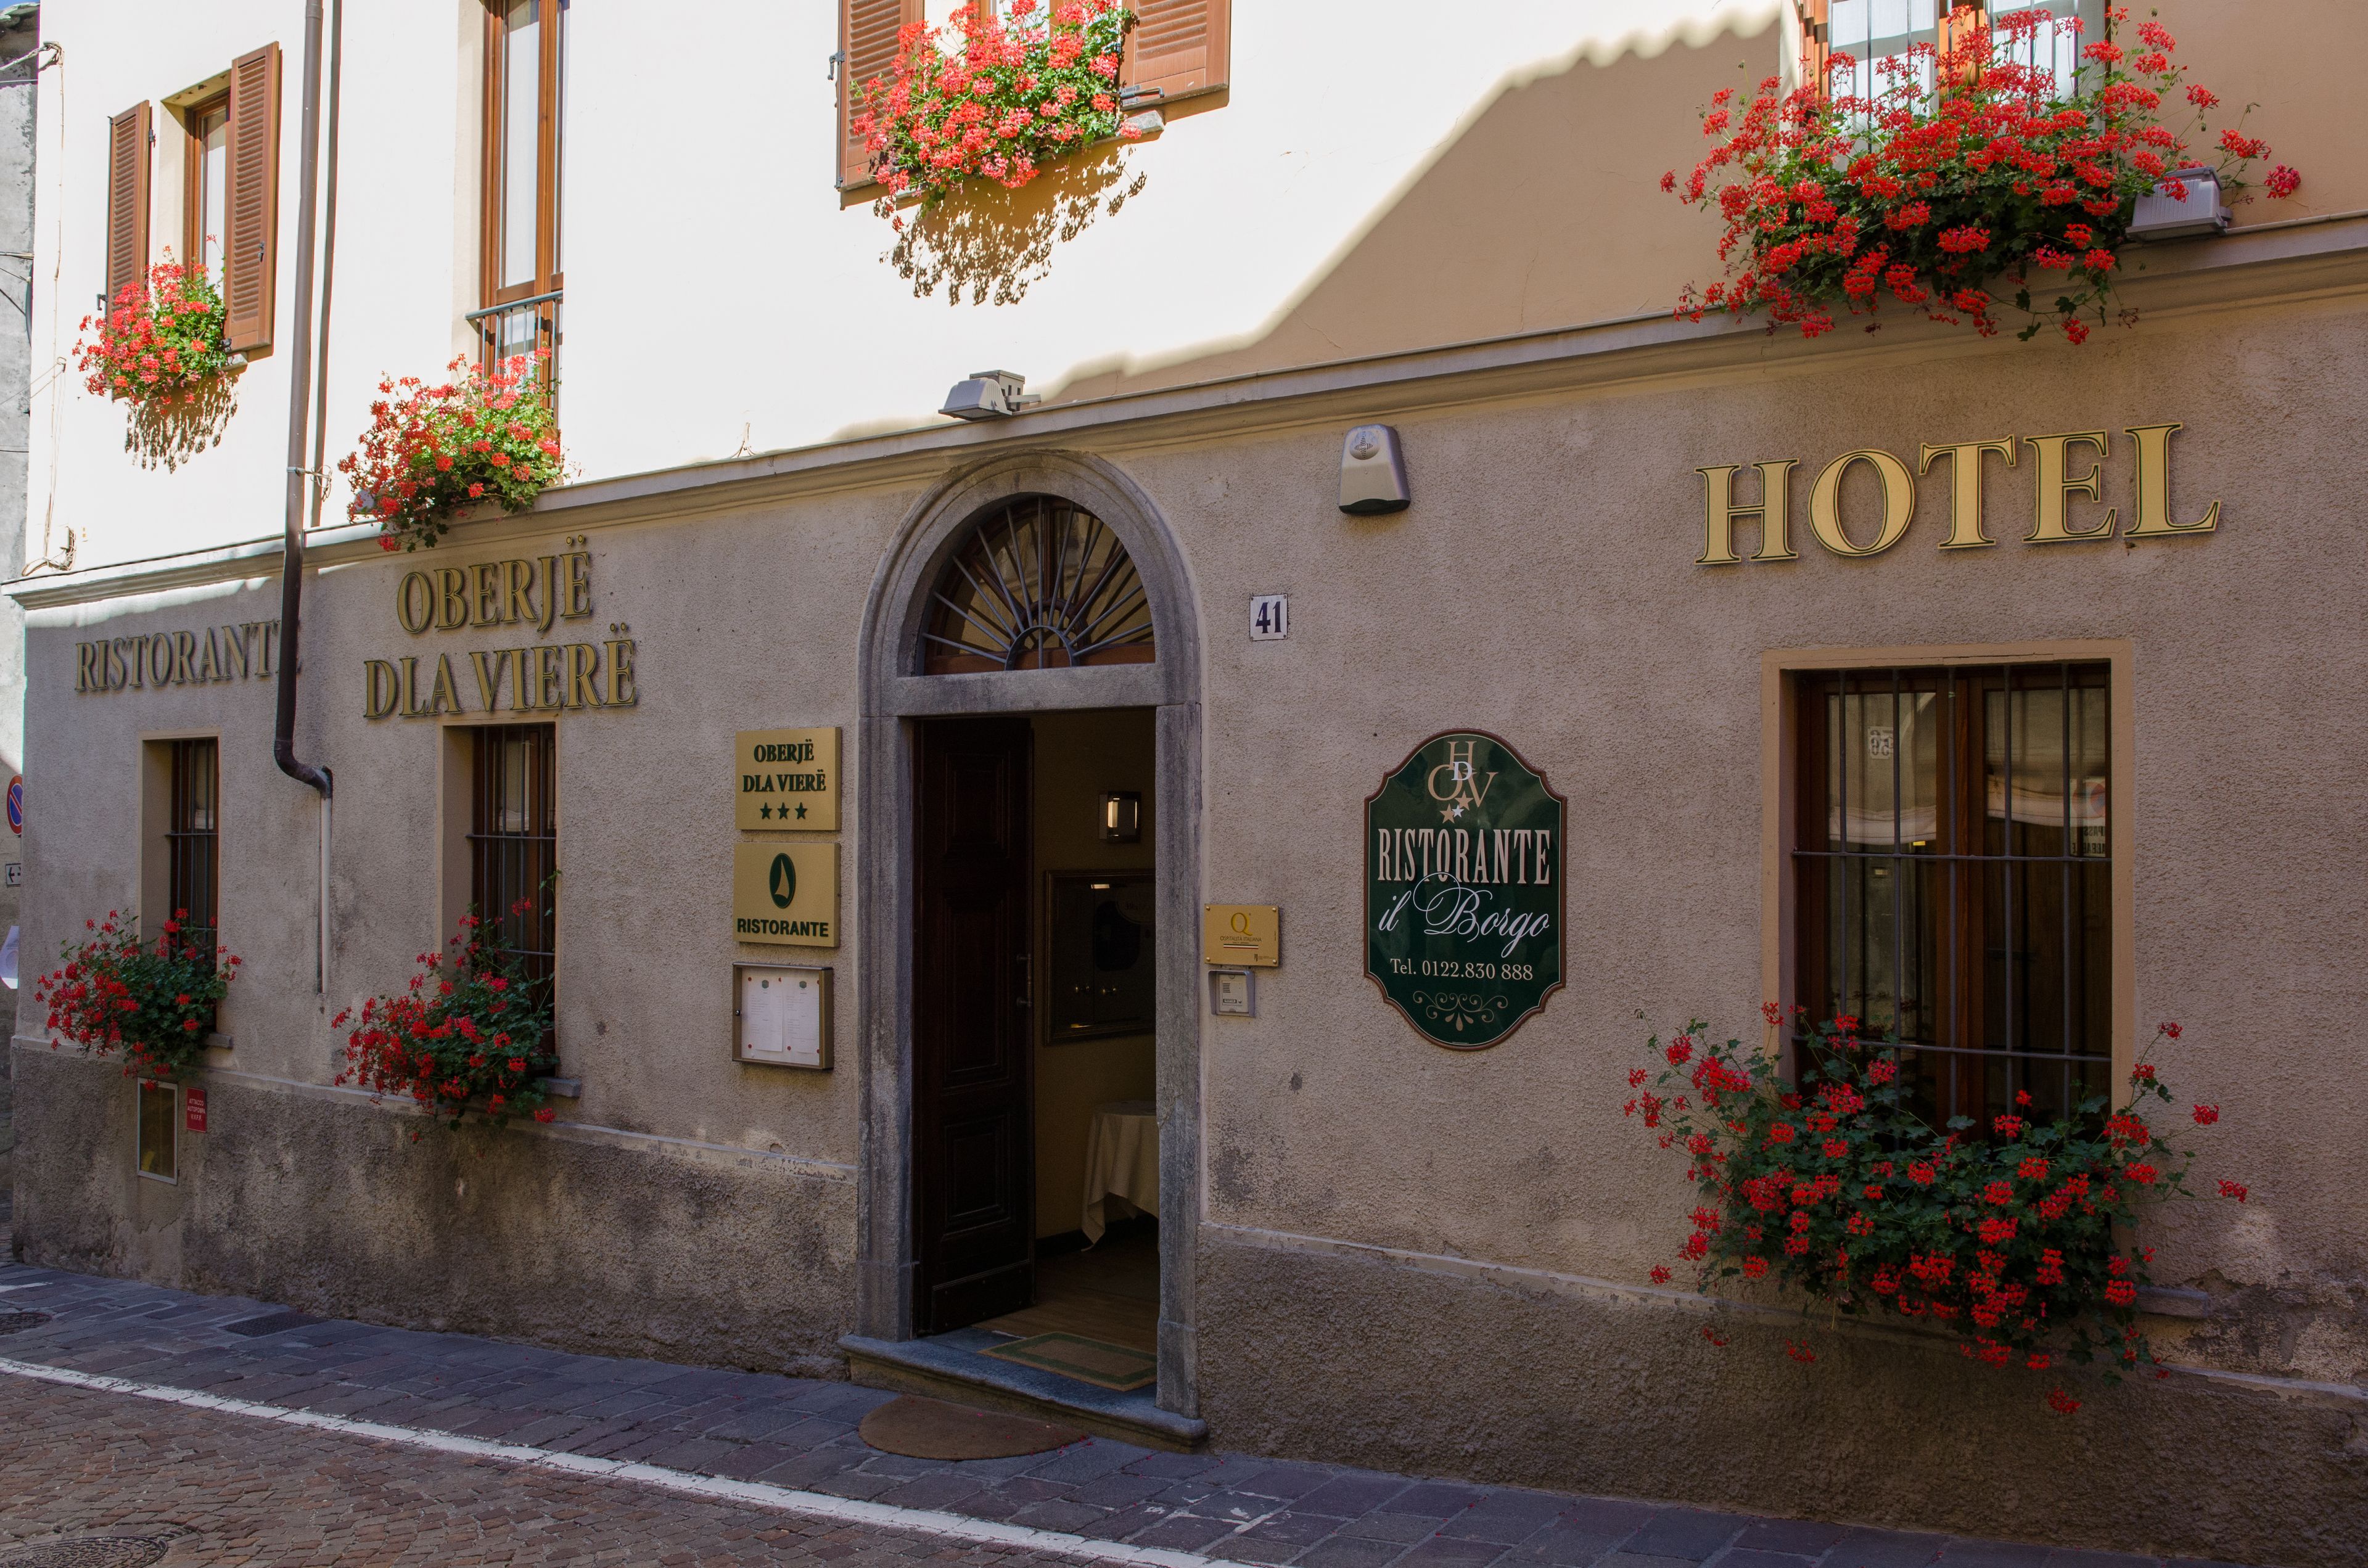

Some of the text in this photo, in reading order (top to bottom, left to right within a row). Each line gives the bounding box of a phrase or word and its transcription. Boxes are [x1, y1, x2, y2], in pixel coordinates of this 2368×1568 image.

[1693, 421, 2221, 566] HOTEL
[397, 533, 591, 634] OBERJË
[1255, 601, 1282, 634] 41
[74, 619, 282, 692] RISTORANT
[754, 738, 815, 765] OBERJË
[742, 768, 826, 793] DLA VIERË
[1377, 827, 1552, 885] RISTORANTE
[737, 917, 829, 938] RISTORANTE
[1230, 912, 1253, 936] Q
[1378, 871, 1550, 958] il Borgo
[1390, 958, 1534, 980] Tel. 0122.830 888
[189, 1098, 204, 1107] ATTACCO
